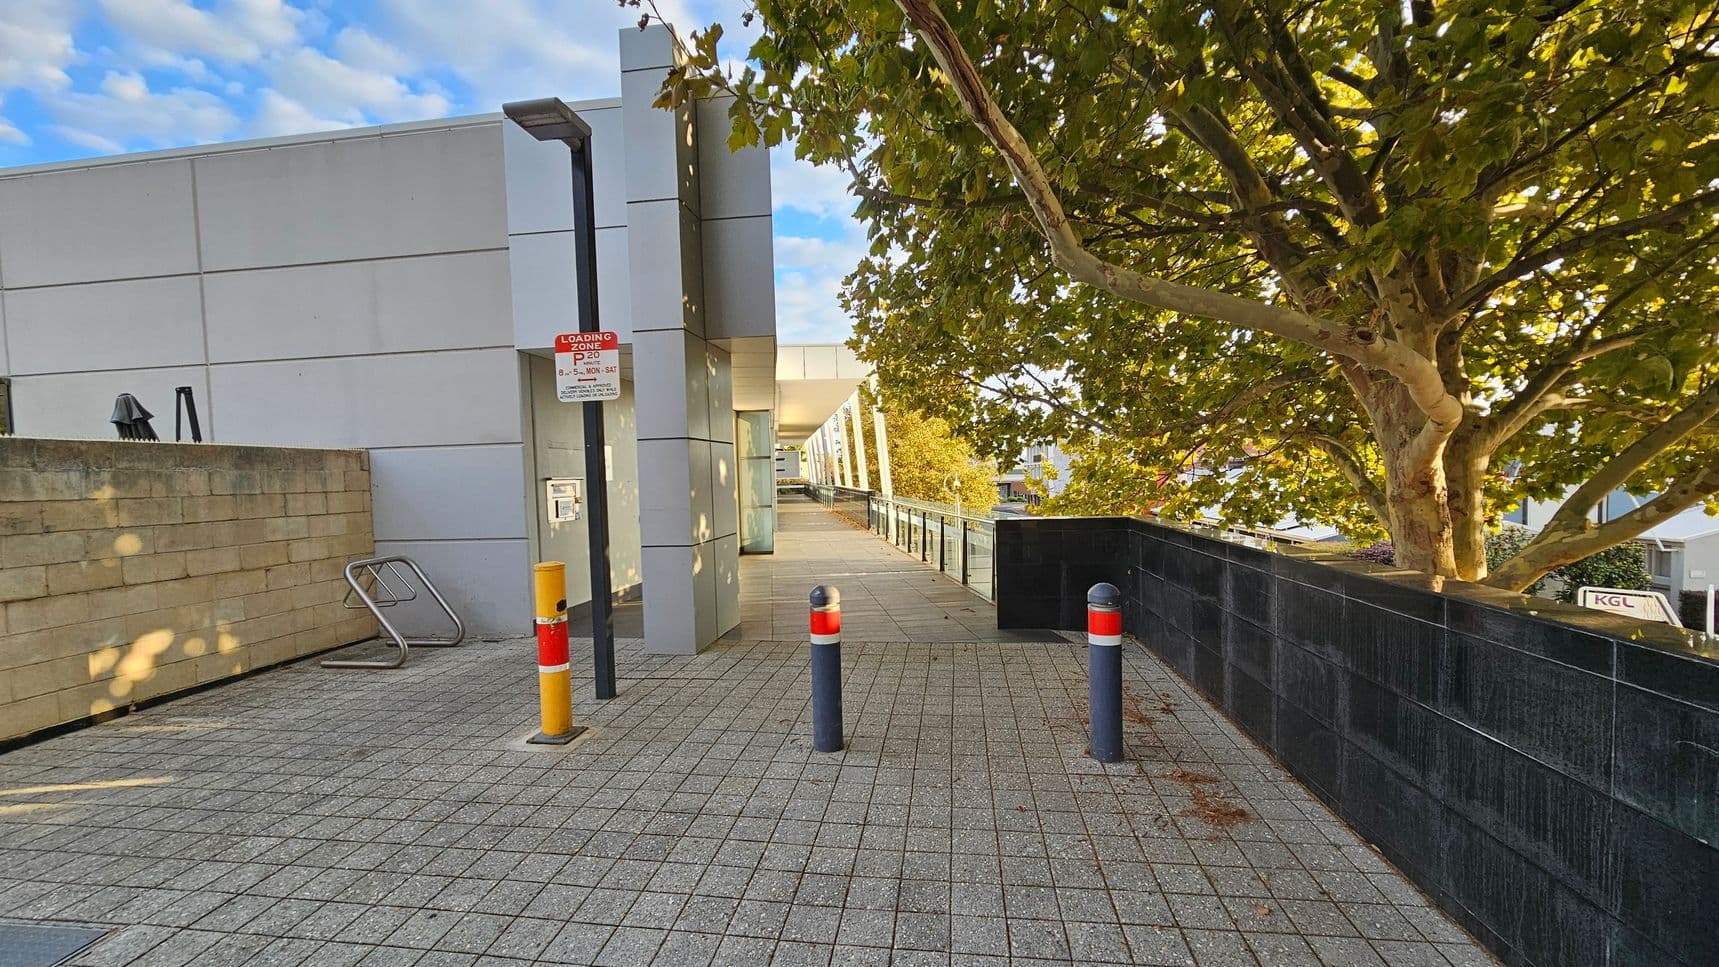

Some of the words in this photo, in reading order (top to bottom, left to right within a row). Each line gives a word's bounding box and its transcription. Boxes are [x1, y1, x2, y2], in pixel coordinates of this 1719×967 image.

[561, 333, 611, 343] LOADING
[571, 342, 602, 351] ZONE
[574, 353, 585, 366] P
[587, 351, 600, 359] 20
[1595, 595, 1634, 608] KGL
